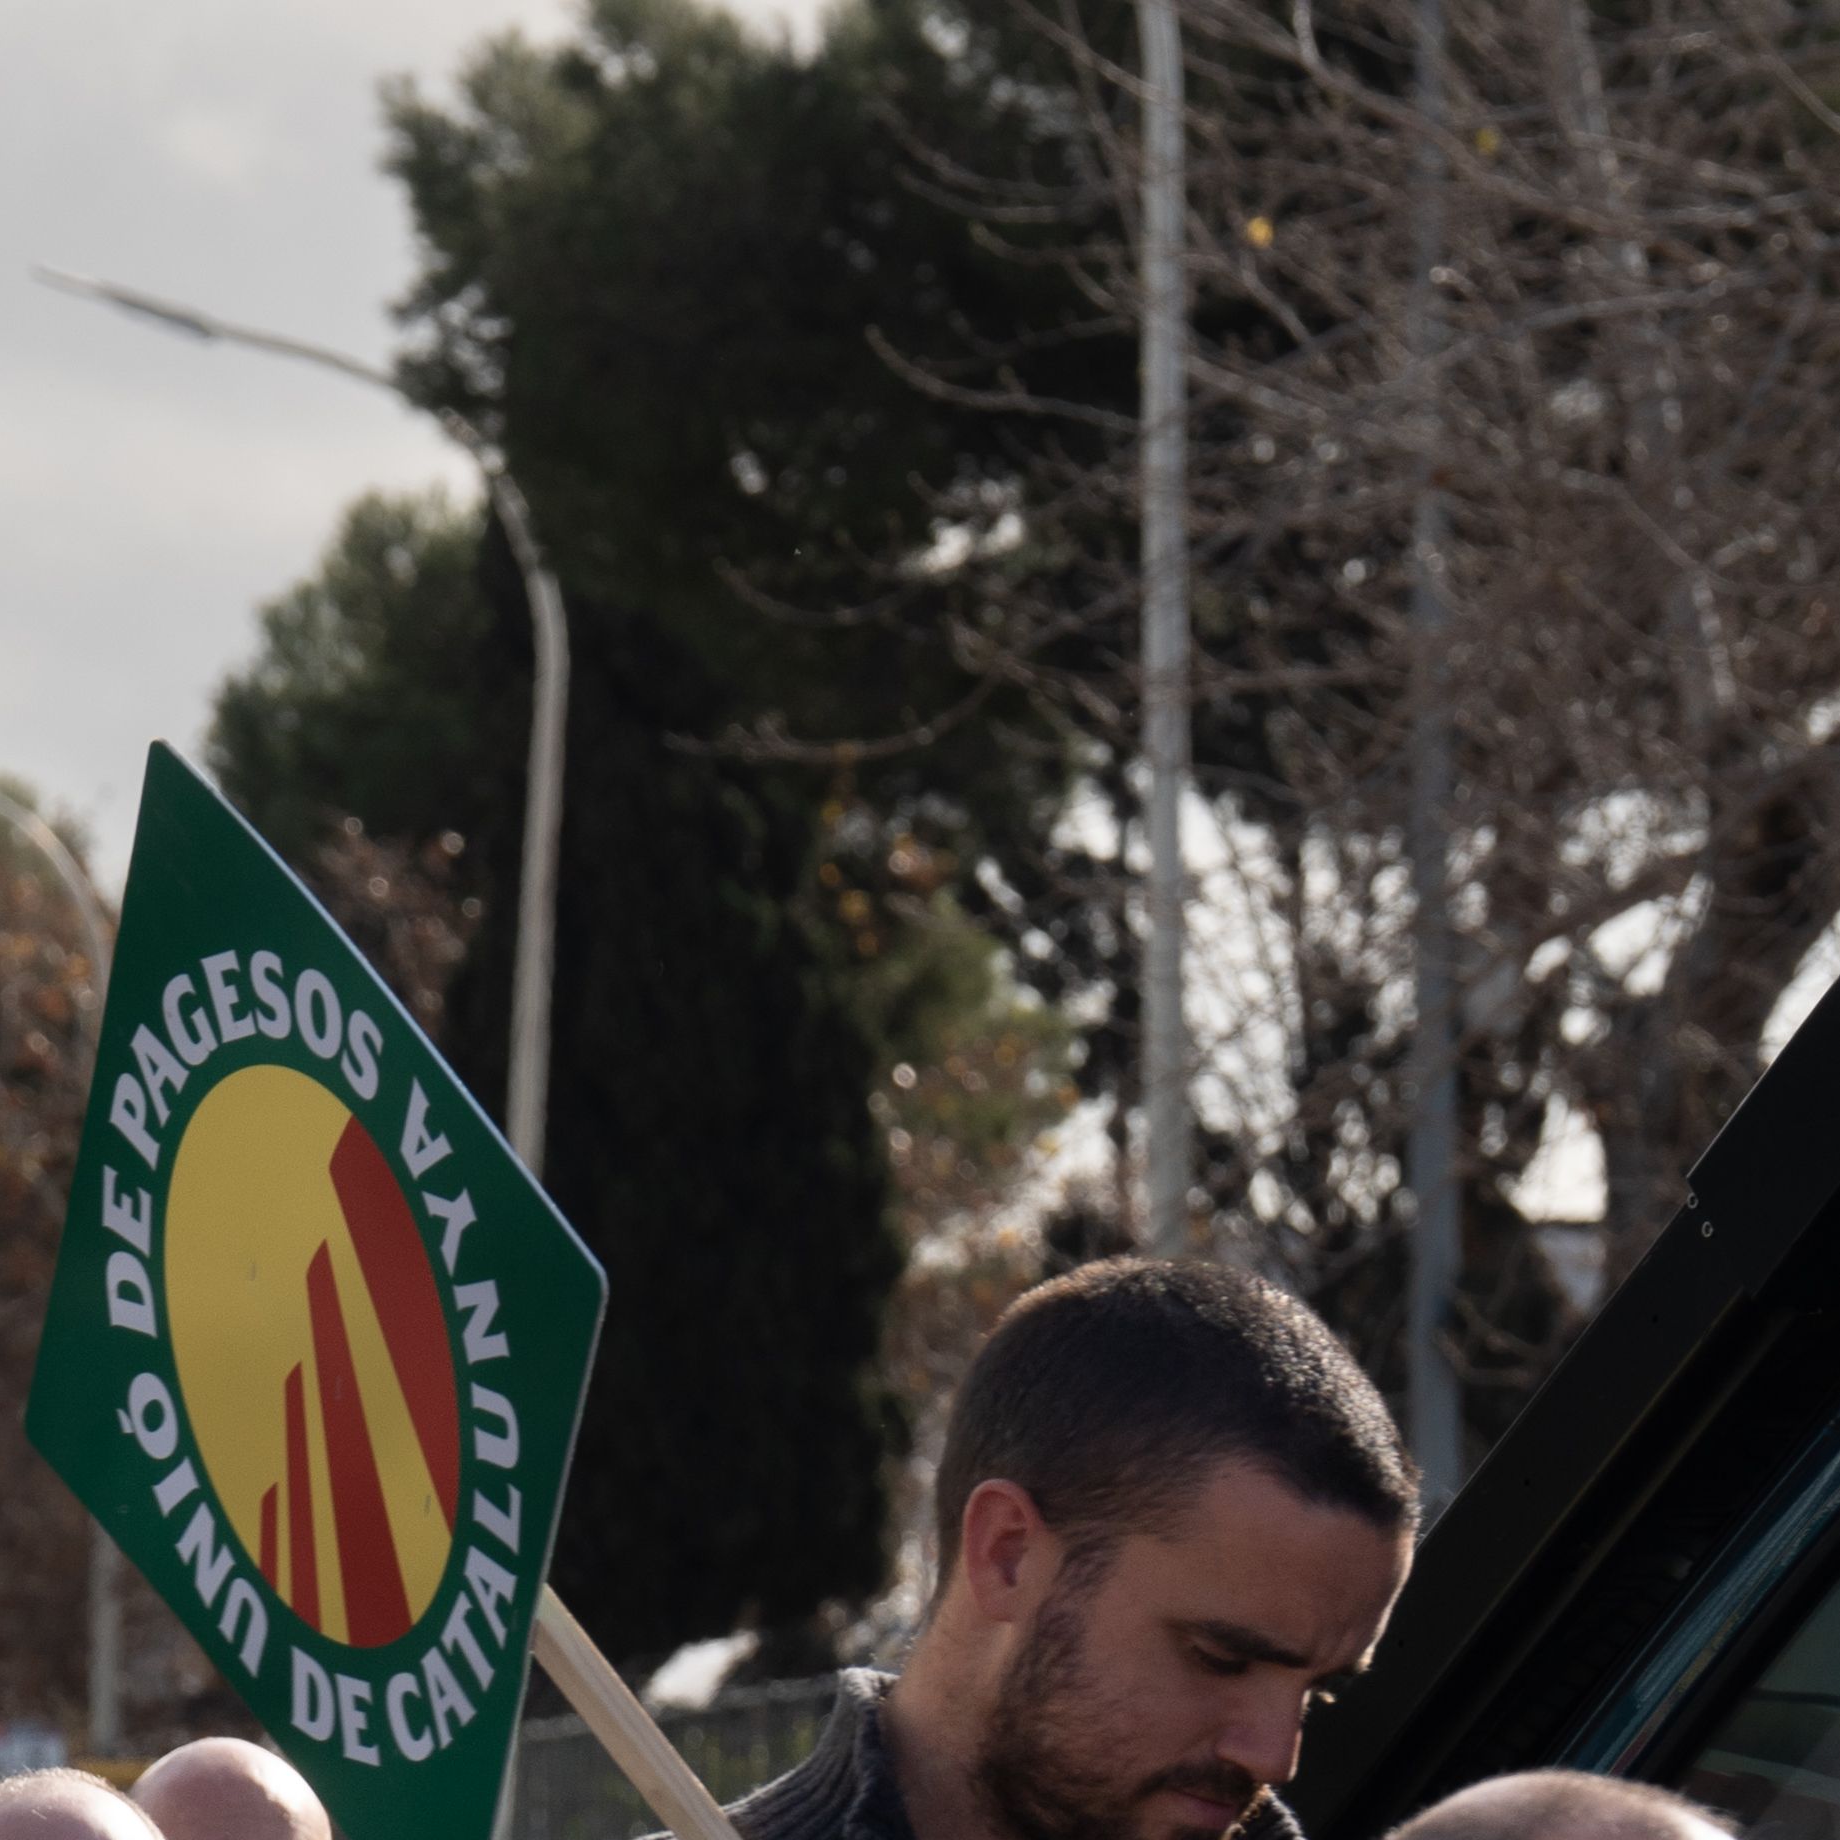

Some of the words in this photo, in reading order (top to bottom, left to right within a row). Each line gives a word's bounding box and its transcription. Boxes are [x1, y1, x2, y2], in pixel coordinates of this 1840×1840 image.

[108, 949, 384, 1172] PAGESOS
[101, 1164, 159, 1338] DE
[115, 1372, 269, 1679] UNIÓ
[290, 1645, 381, 1767] DE
[385, 1075, 522, 1763] CATALUNYA
